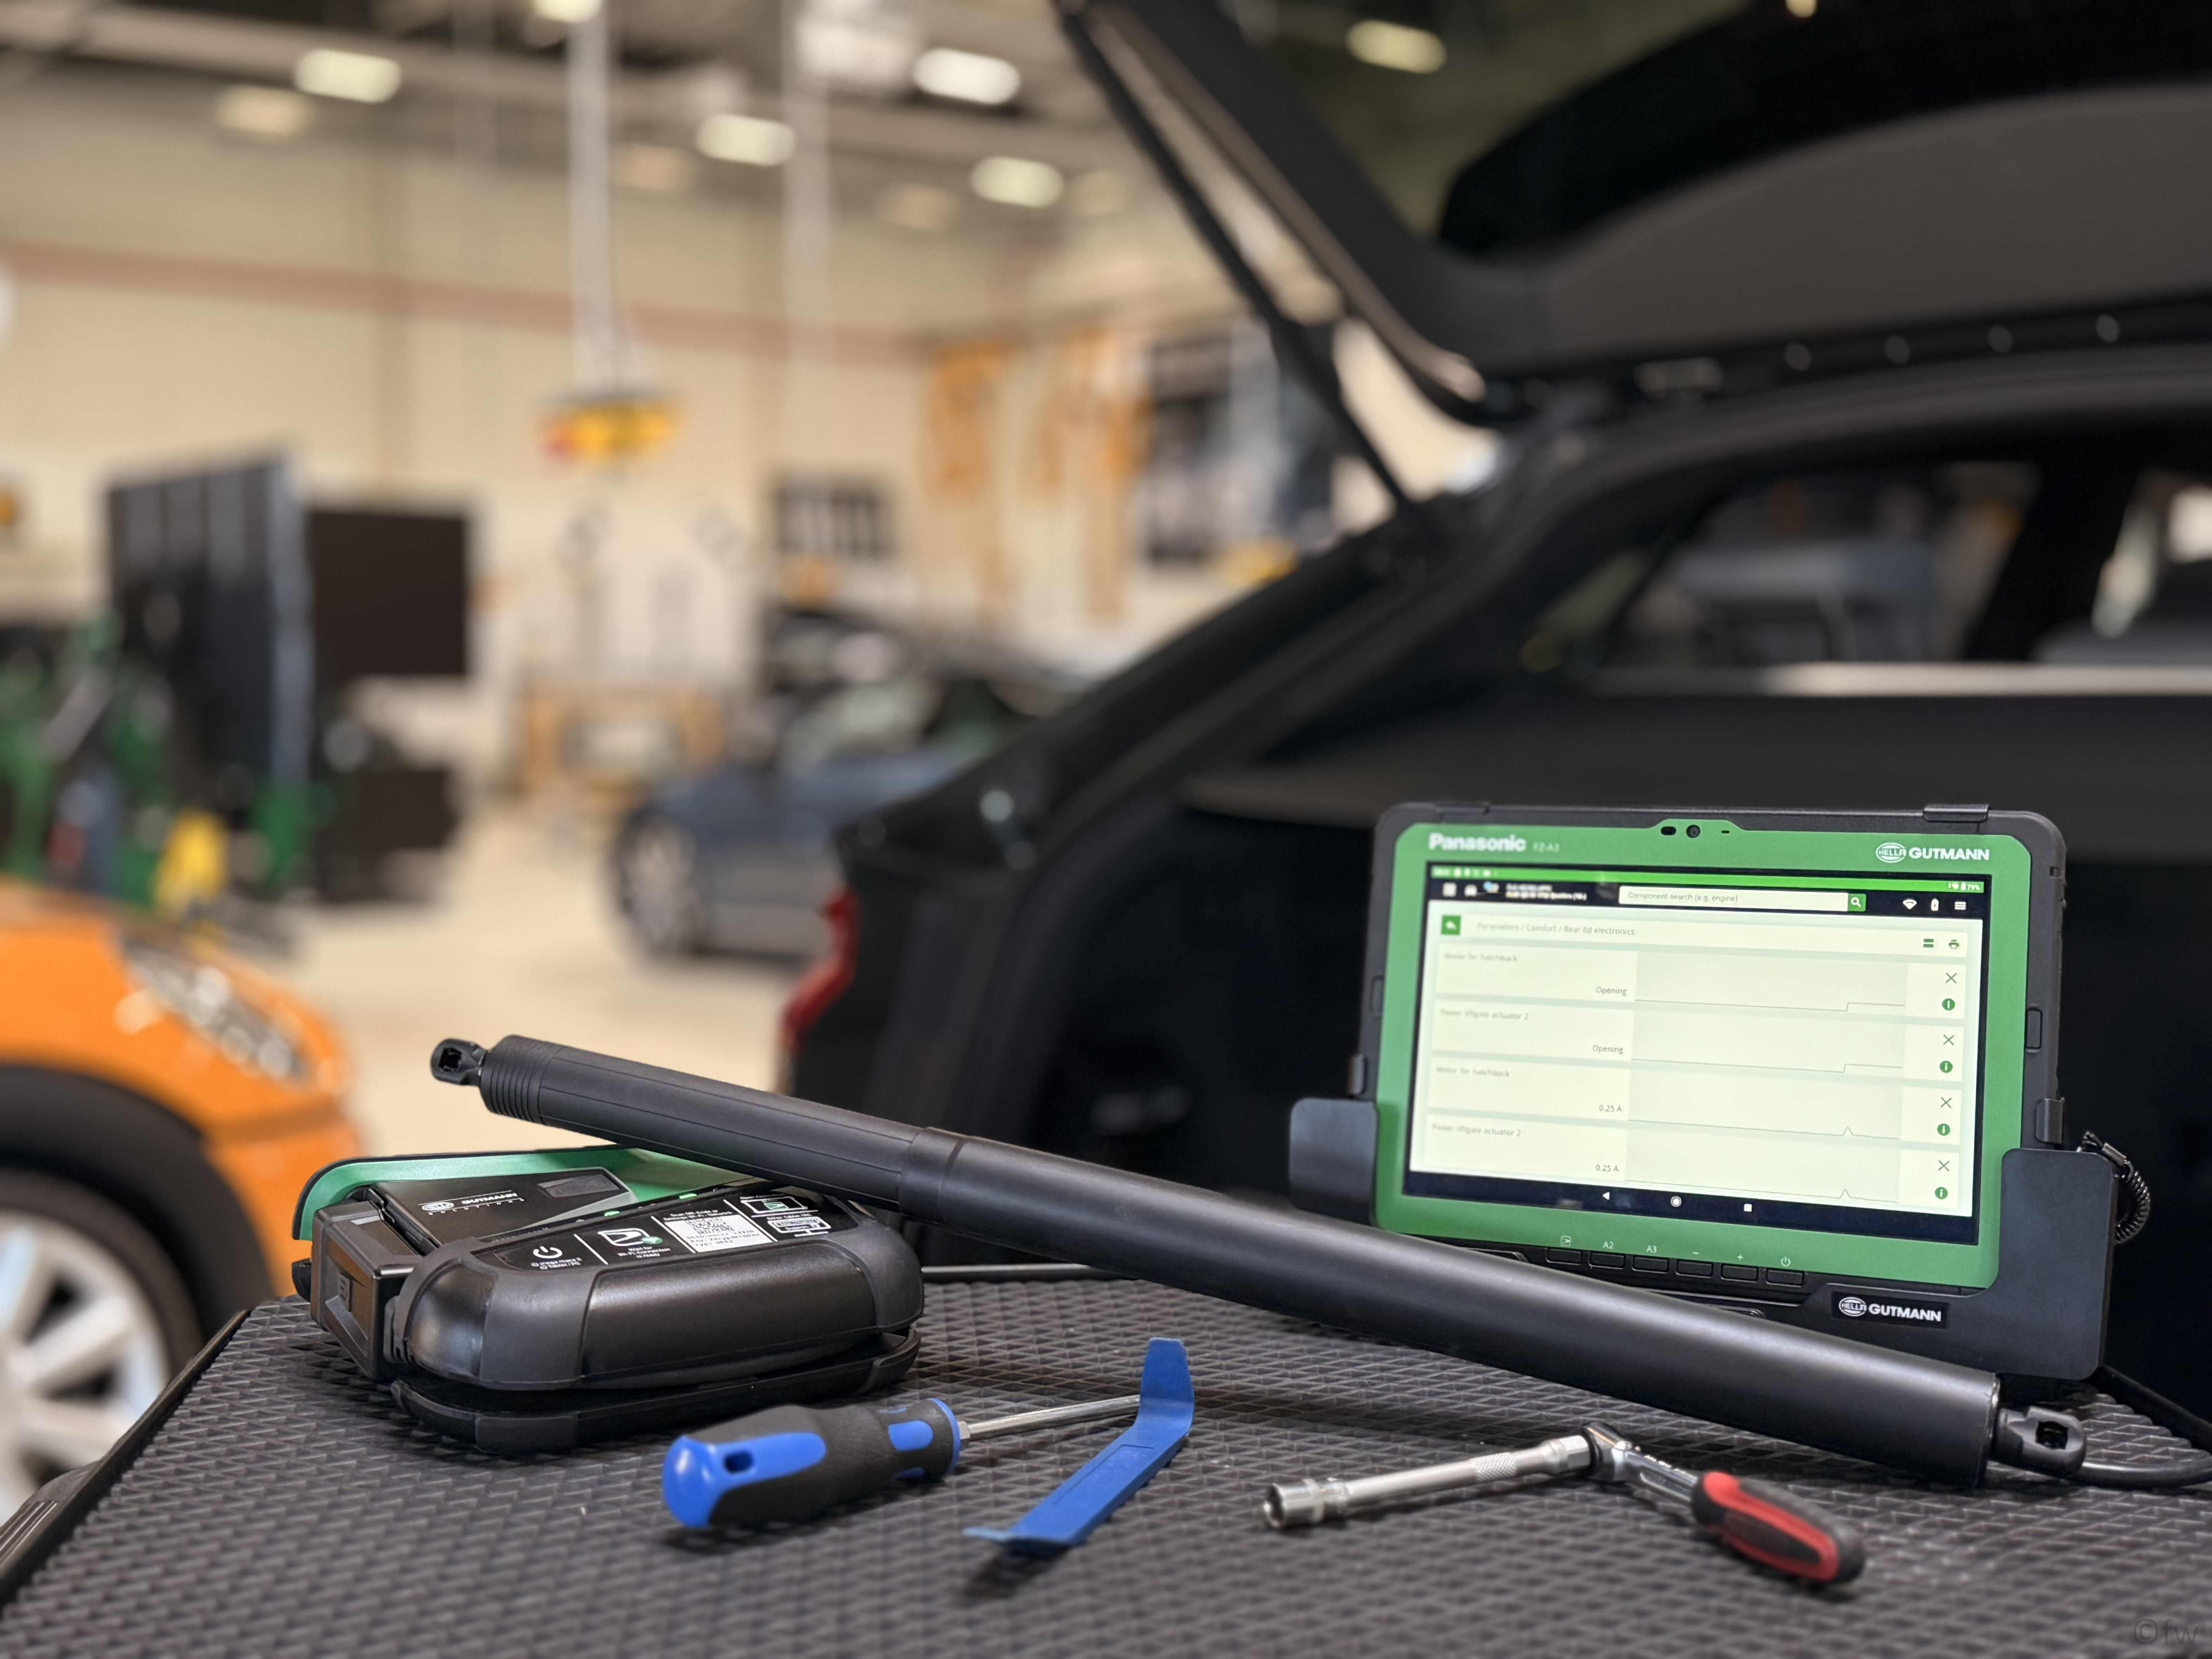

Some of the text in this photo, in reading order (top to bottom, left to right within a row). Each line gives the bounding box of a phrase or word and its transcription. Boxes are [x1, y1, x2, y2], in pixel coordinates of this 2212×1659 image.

[1429, 833, 1527, 852] Panasonic
[1909, 847, 1989, 860] GUTMANN
[1594, 927, 1635, 935] electronics
[1596, 986, 1627, 996] Opening
[1592, 1044, 1623, 1054] Opening
[1602, 1241, 1614, 1249] A2
[1646, 1245, 1657, 1253] A3
[1869, 1304, 1941, 1322] GUTMANN
